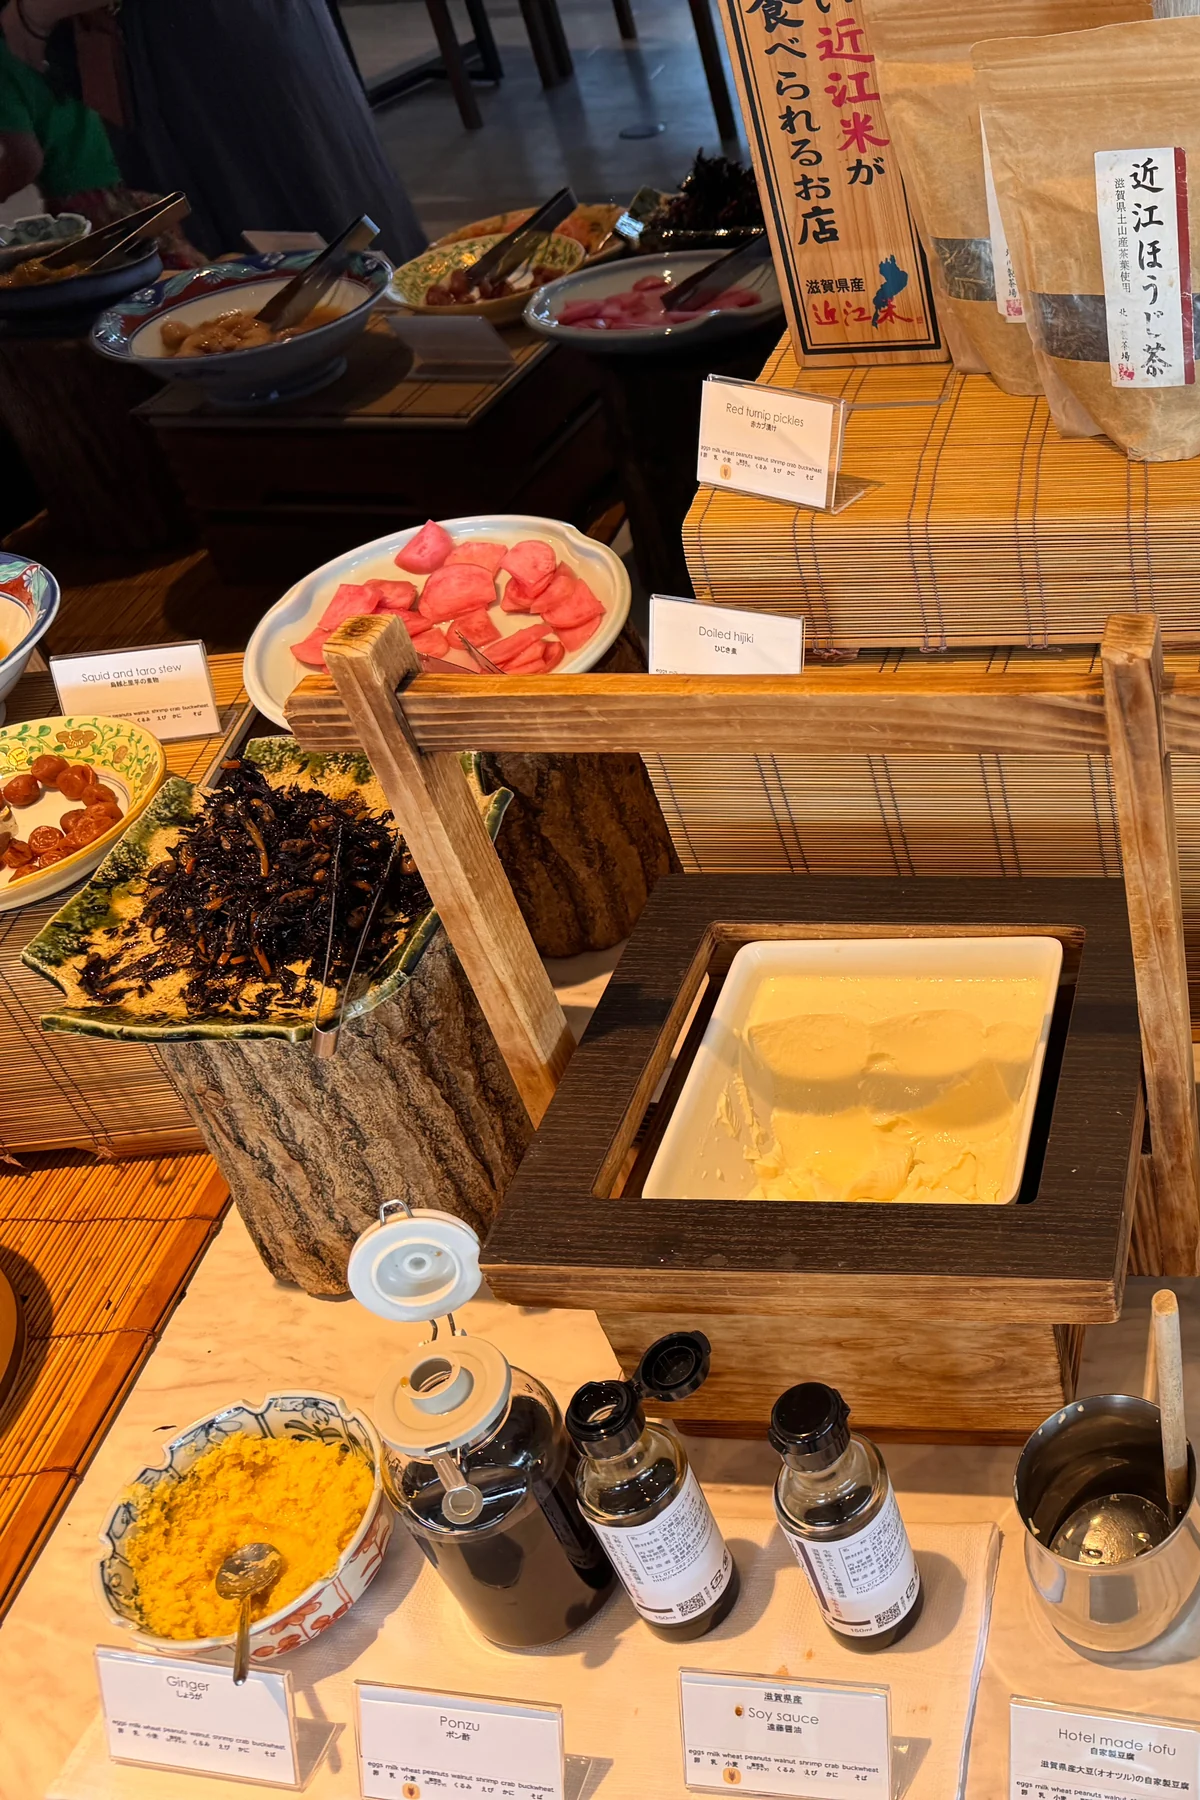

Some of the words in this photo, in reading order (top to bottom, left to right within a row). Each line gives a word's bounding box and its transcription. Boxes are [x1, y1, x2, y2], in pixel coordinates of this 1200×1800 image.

[1114, 178, 1131, 293] 滋賀県土山産茶葉使用
[806, 277, 866, 295] 滋賀県産
[726, 403, 744, 415] Red
[746, 407, 771, 422] turnip
[773, 413, 804, 427] pickles
[734, 631, 753, 644] hijiki
[82, 669, 110, 683] Squid
[113, 668, 133, 678] and
[136, 667, 156, 676] taro
[159, 664, 182, 673] stew
[166, 1676, 210, 1692] Ginger
[176, 1690, 203, 1700] しょうが
[764, 1692, 803, 1705] 滋賀県産
[439, 1716, 480, 1732] Ponzu
[748, 1707, 773, 1721] Soy
[776, 1712, 819, 1725] sauce
[446, 1731, 470, 1741] ポン酢
[1058, 1728, 1095, 1744] Hotel
[1100, 1734, 1143, 1751] made
[1148, 1743, 1176, 1757] tofu
[1090, 1747, 1135, 1761] 自家製豆腐
[745, 1754, 772, 1762] peanuts
[774, 1757, 796, 1765] walnut
[800, 1760, 822, 1768] shrimp
[842, 1764, 879, 1773] buckwheat
[368, 1761, 383, 1769] eggs
[401, 1766, 420, 1774] wheat
[422, 1769, 449, 1778] peanuts
[451, 1773, 473, 1781] walnut
[476, 1776, 498, 1785] shrimp
[518, 1782, 554, 1793] buckwheat
[1016, 1780, 1032, 1788] eggs
[1035, 1783, 1049, 1791] milk
[1051, 1786, 1071, 1794] wheat
[1074, 1789, 1101, 1798] peanuts
